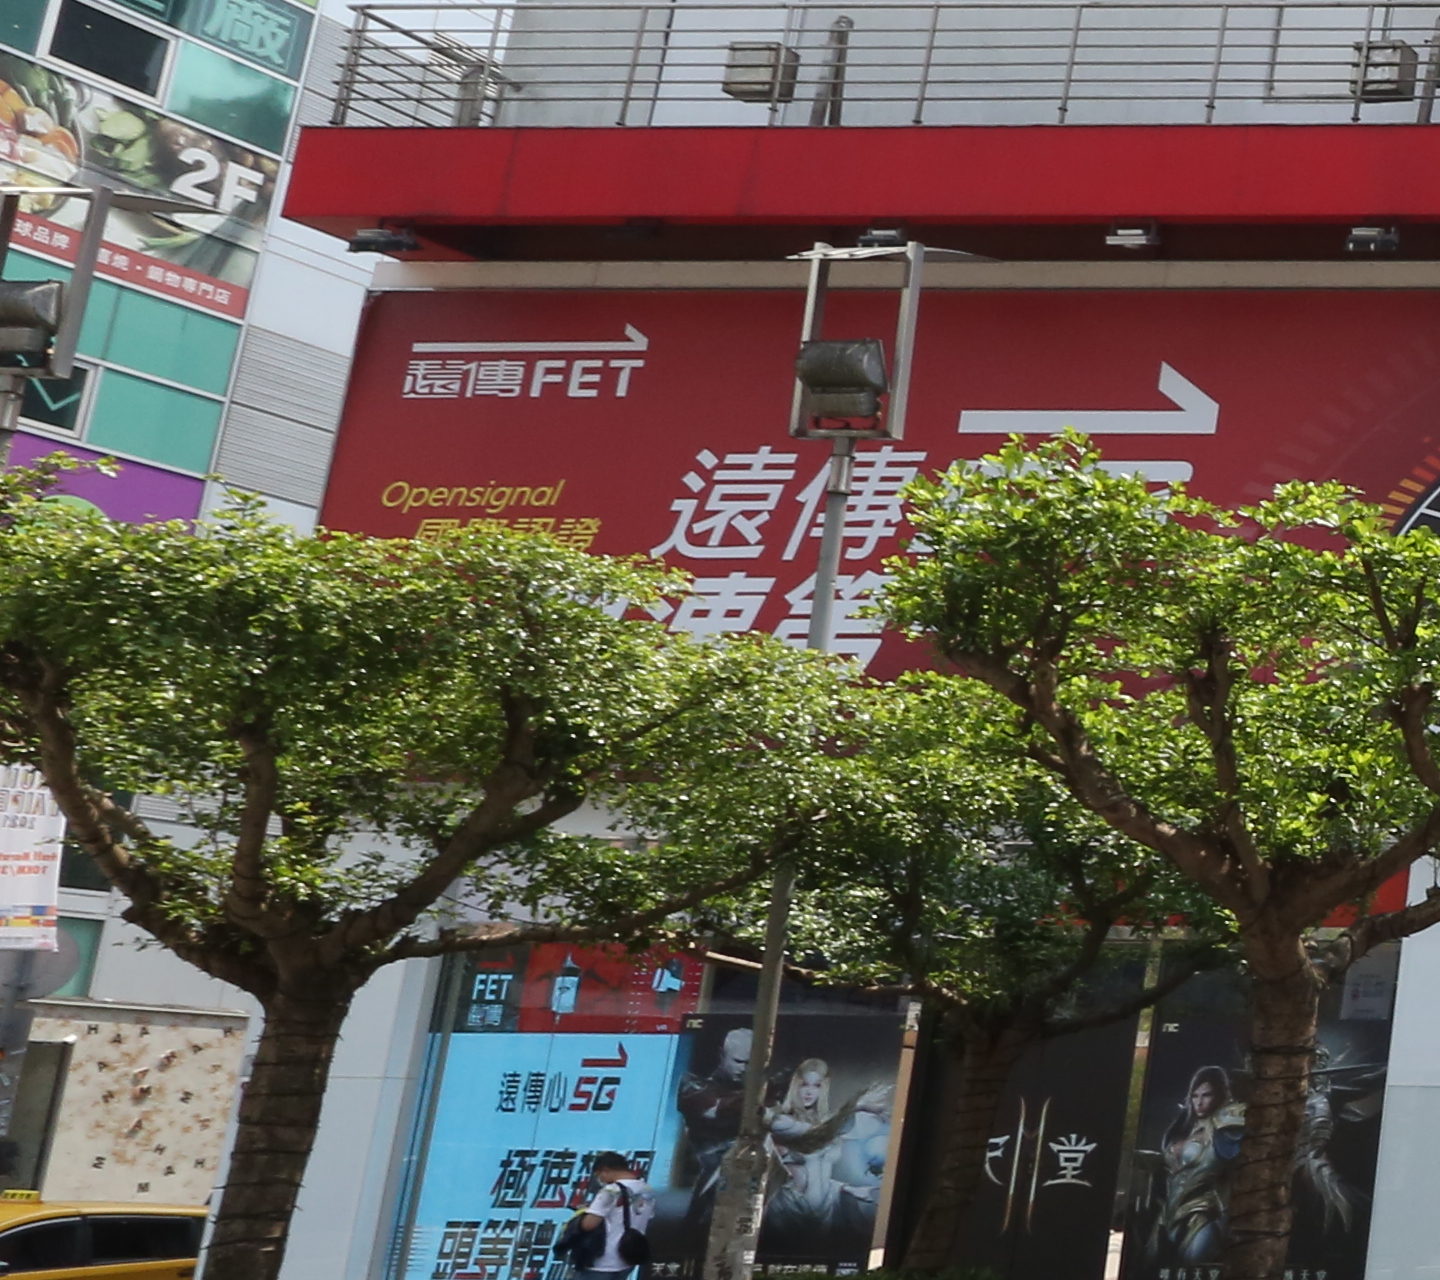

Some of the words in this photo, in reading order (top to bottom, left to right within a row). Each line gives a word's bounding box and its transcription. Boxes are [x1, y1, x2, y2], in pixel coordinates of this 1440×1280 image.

[170, 147, 264, 213] 2F
[380, 479, 566, 515] Opensignal
[472, 974, 513, 1001] FET
